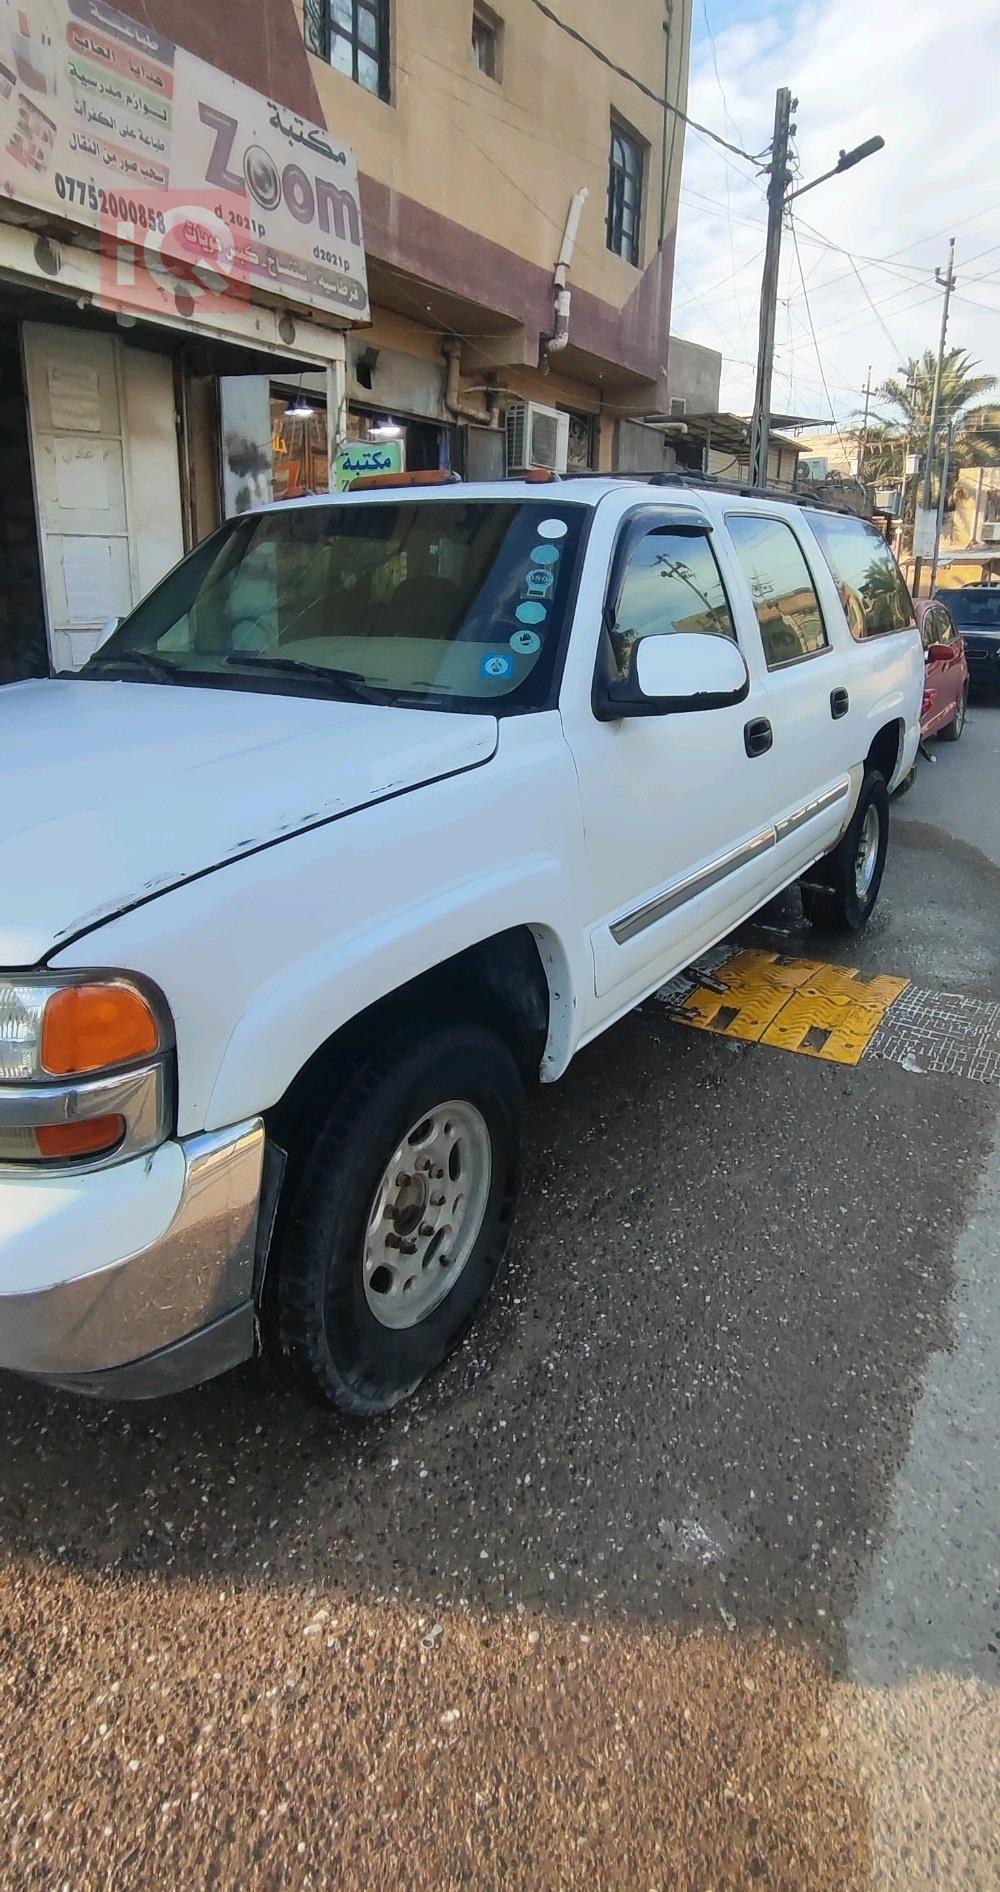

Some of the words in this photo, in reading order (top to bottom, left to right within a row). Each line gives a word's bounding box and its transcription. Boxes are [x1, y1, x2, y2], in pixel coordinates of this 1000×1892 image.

[67, 60, 122, 98] مدرسية
[128, 58, 164, 87] هدايا
[126, 92, 168, 122] لوازم
[69, 132, 101, 156] النقال
[138, 128, 166, 152] طباعة
[267, 100, 347, 166] مكتبة
[102, 146, 118, 166] من
[119, 160, 138, 173] صور
[140, 166, 164, 184] سحب
[54, 171, 166, 235] 07752000858
[213, 203, 266, 239] d_2021p
[312, 246, 350, 273] d2021p
[318, 270, 360, 303] قرطاسية
[339, 451, 392, 477] مكتبة
